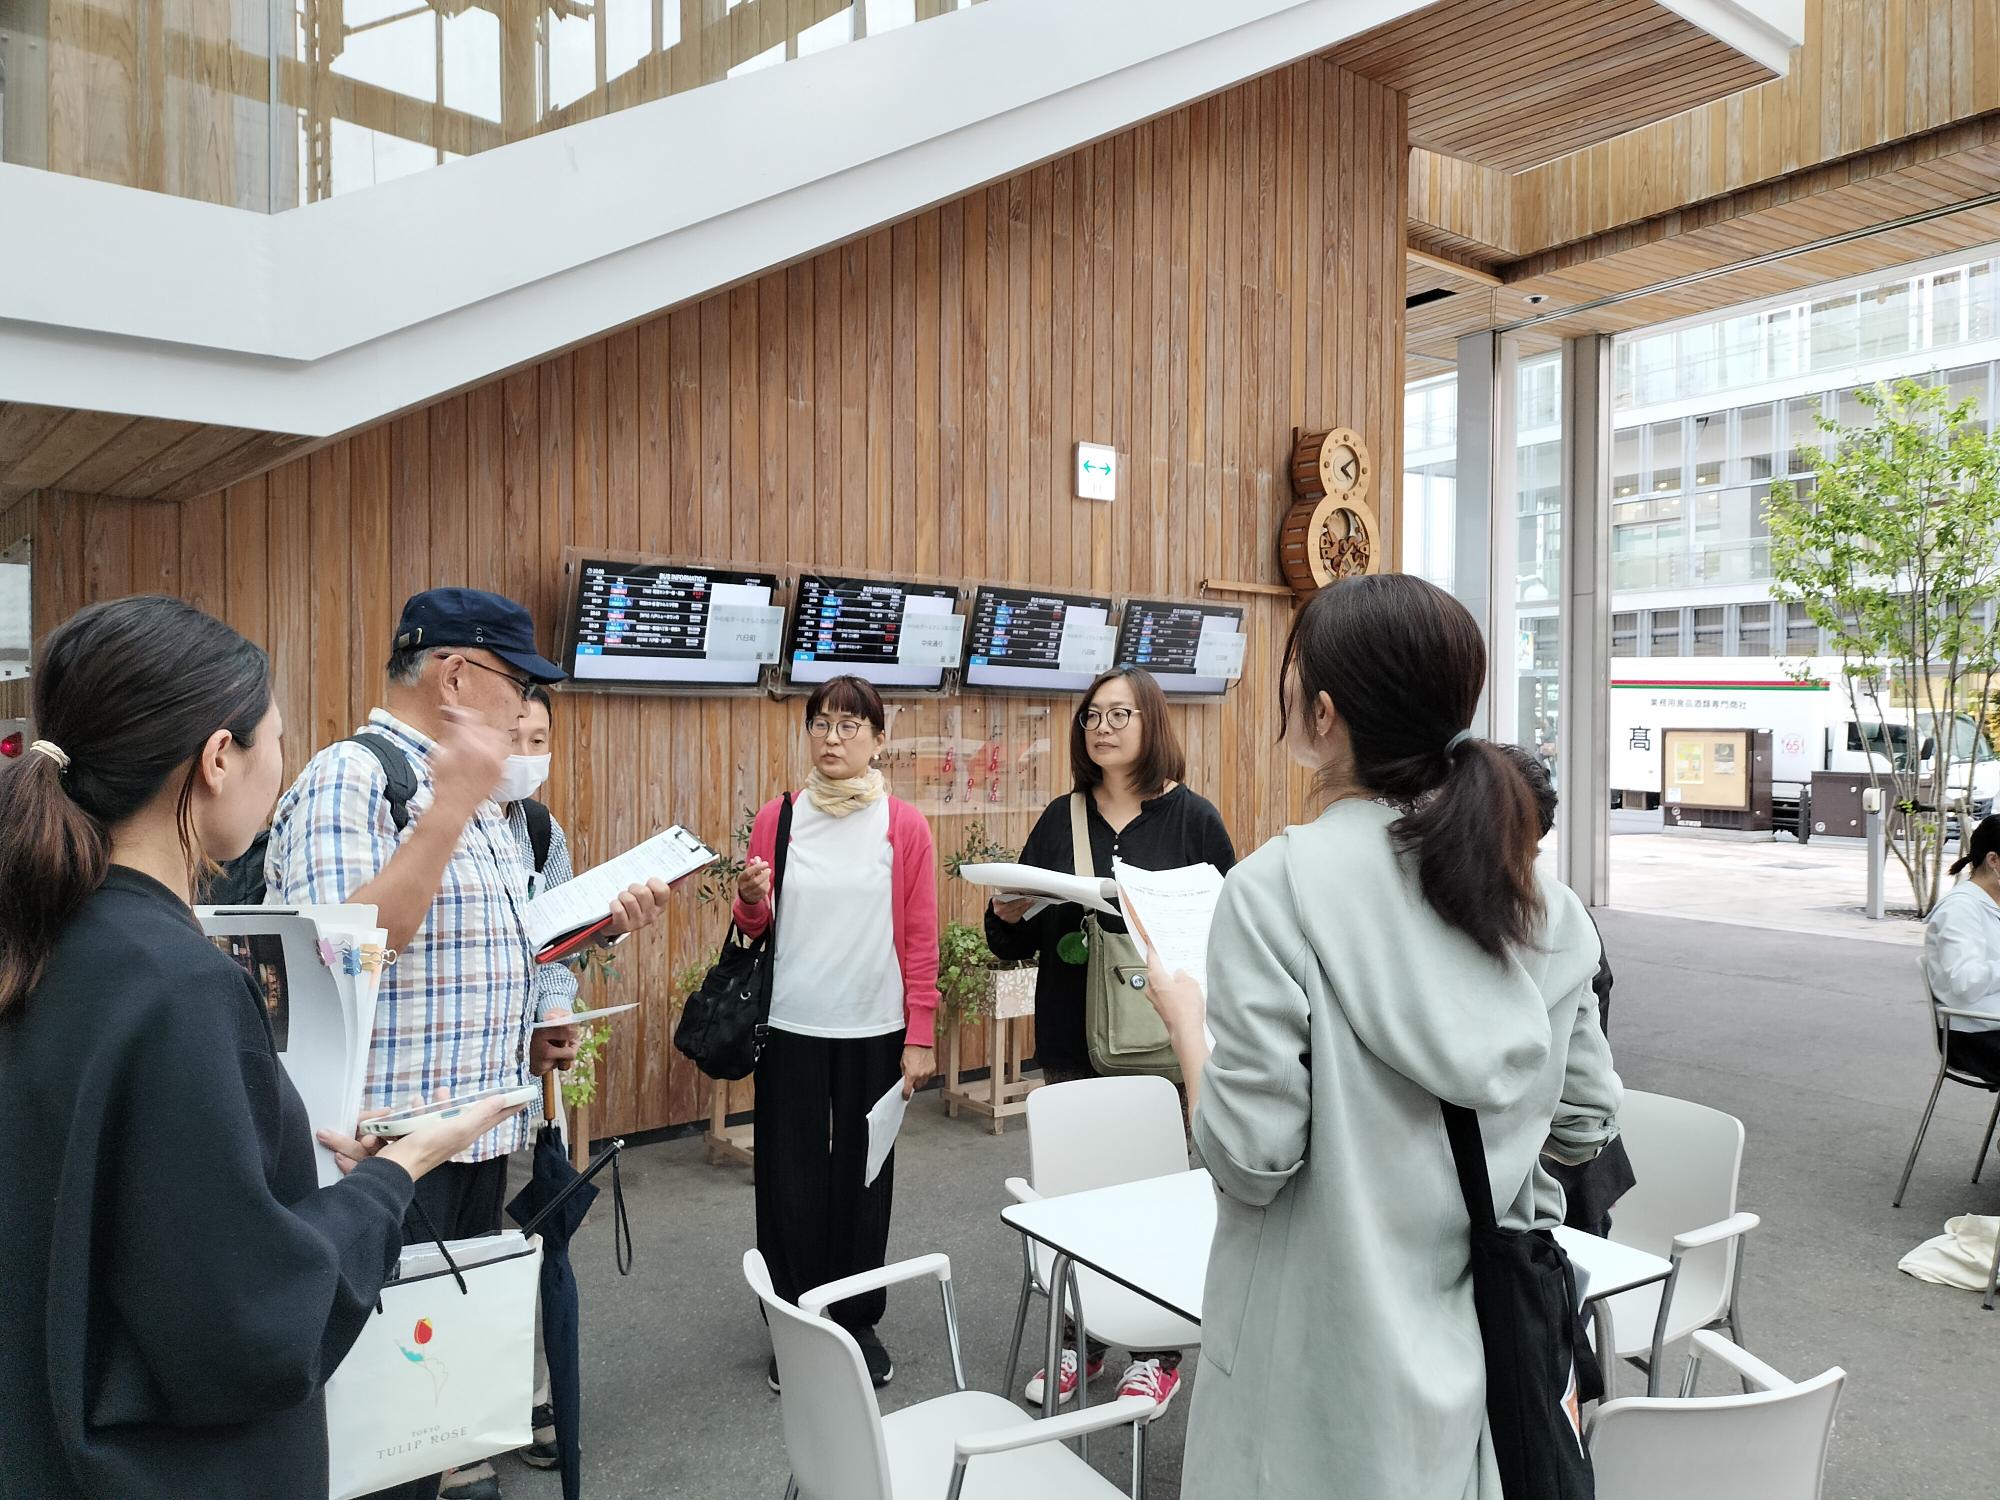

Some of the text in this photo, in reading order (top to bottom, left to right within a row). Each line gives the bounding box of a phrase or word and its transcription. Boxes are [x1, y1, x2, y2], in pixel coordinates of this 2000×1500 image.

[659, 572, 707, 583] BUS INFORMATION
[1629, 725, 1651, 751] 高
[1785, 739, 1800, 751] 65
[411, 1425, 441, 1438] TOKYO
[376, 1426, 467, 1460] TULIP ROSE
